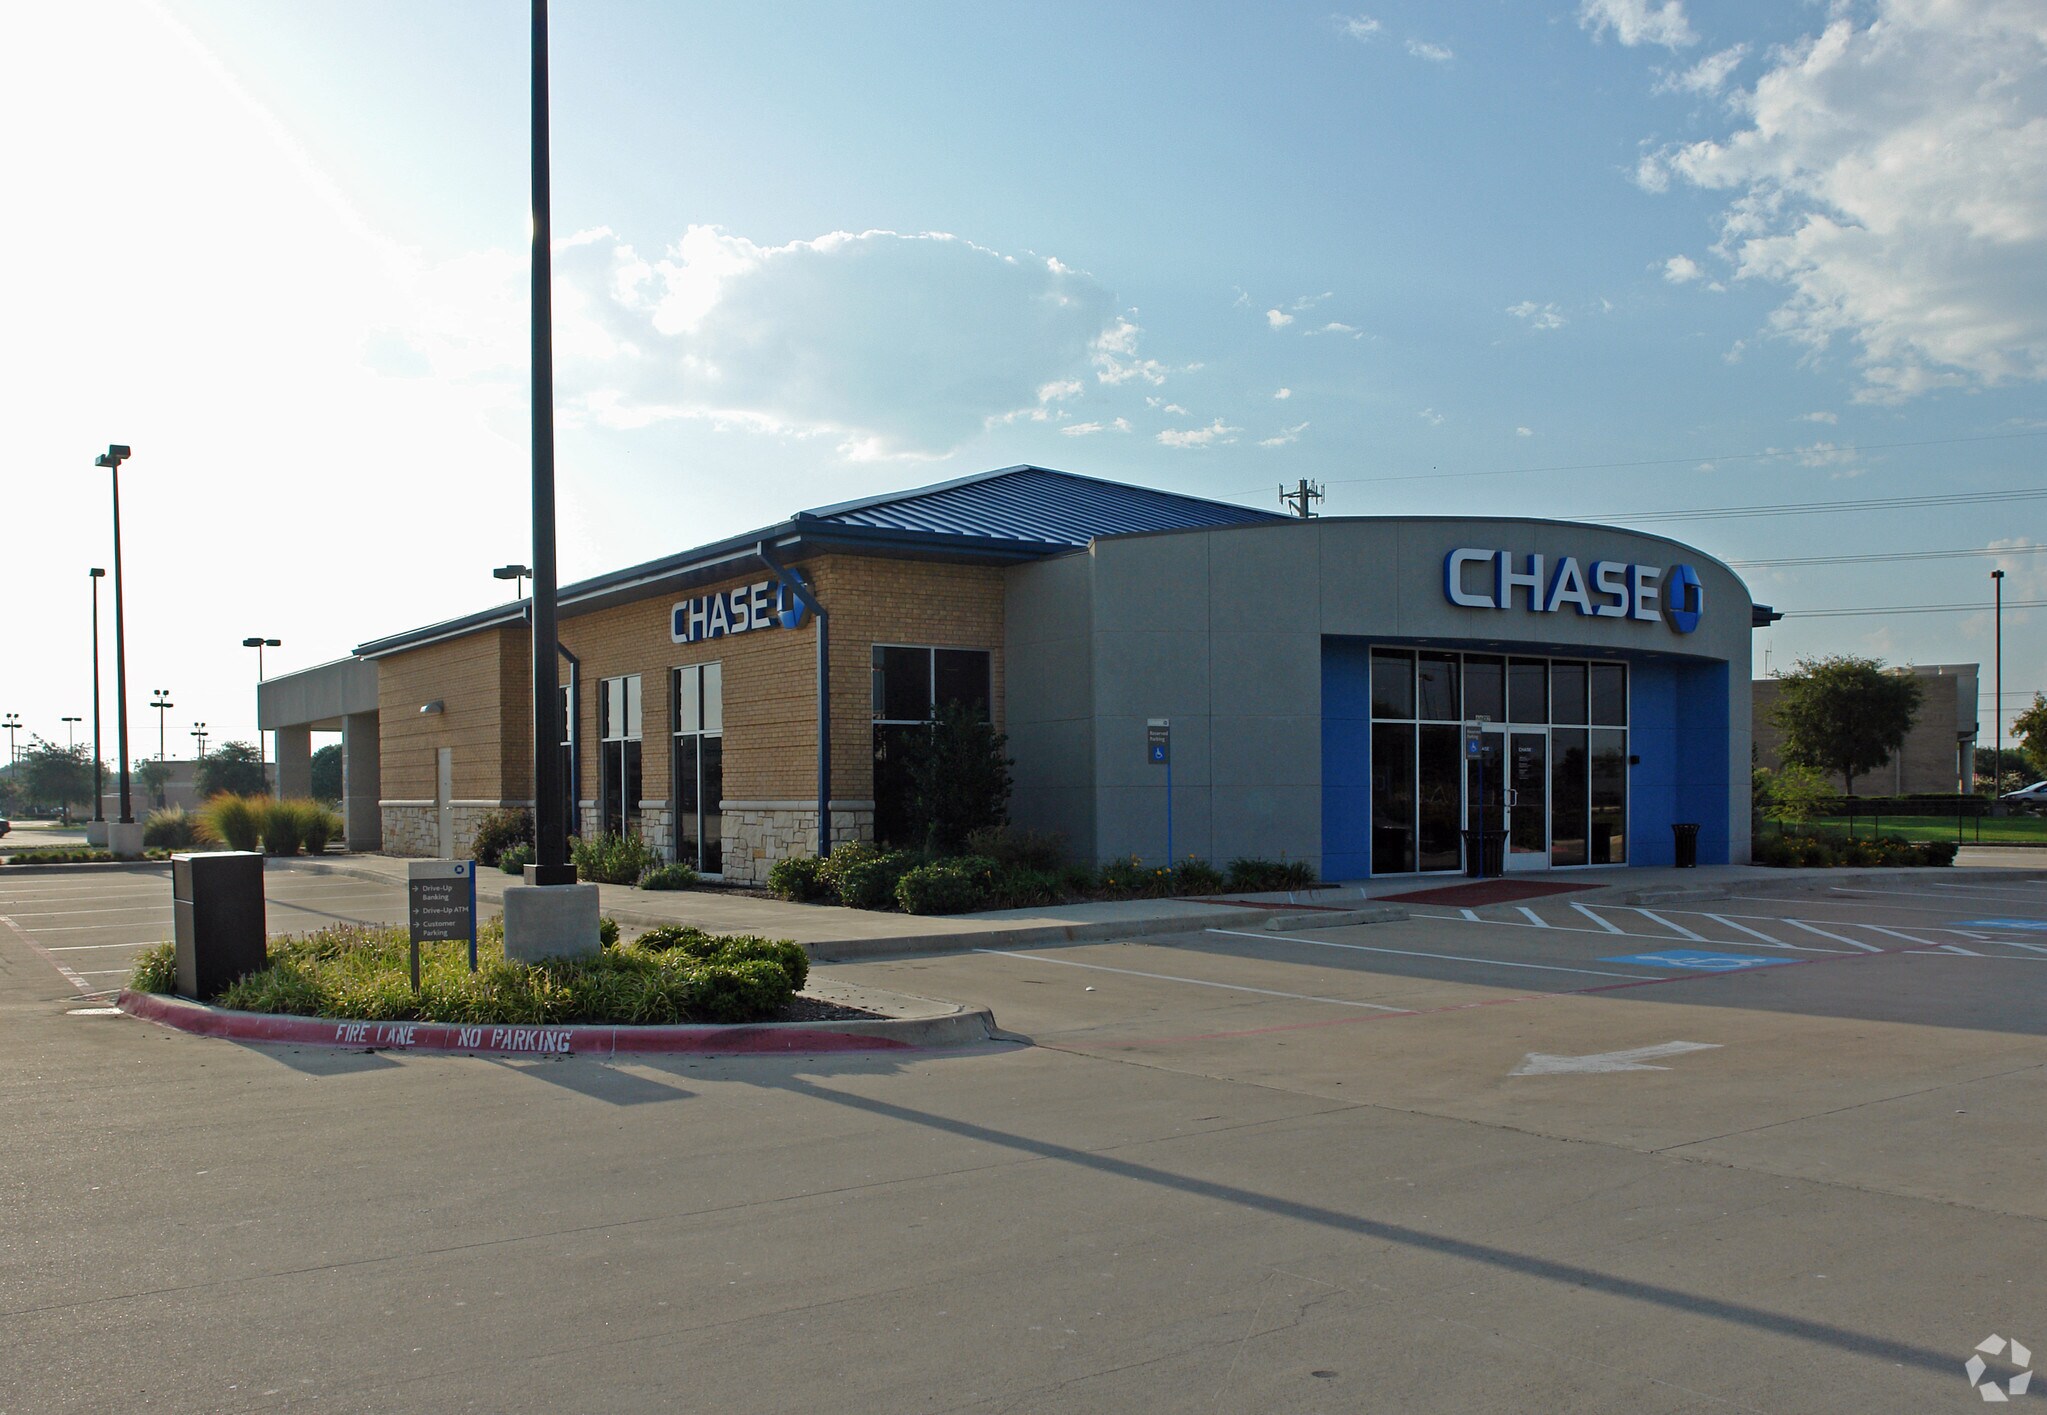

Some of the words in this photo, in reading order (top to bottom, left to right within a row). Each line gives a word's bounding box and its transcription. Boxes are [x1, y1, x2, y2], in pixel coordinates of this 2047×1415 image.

[1444, 548, 1662, 622] CHASE
[671, 581, 771, 644] CHASE
[422, 885, 452, 893] Drive-Up
[423, 893, 449, 901] Banking
[335, 1022, 371, 1043] FIRE
[458, 1027, 483, 1048] NO
[491, 1028, 574, 1053] PARKING
